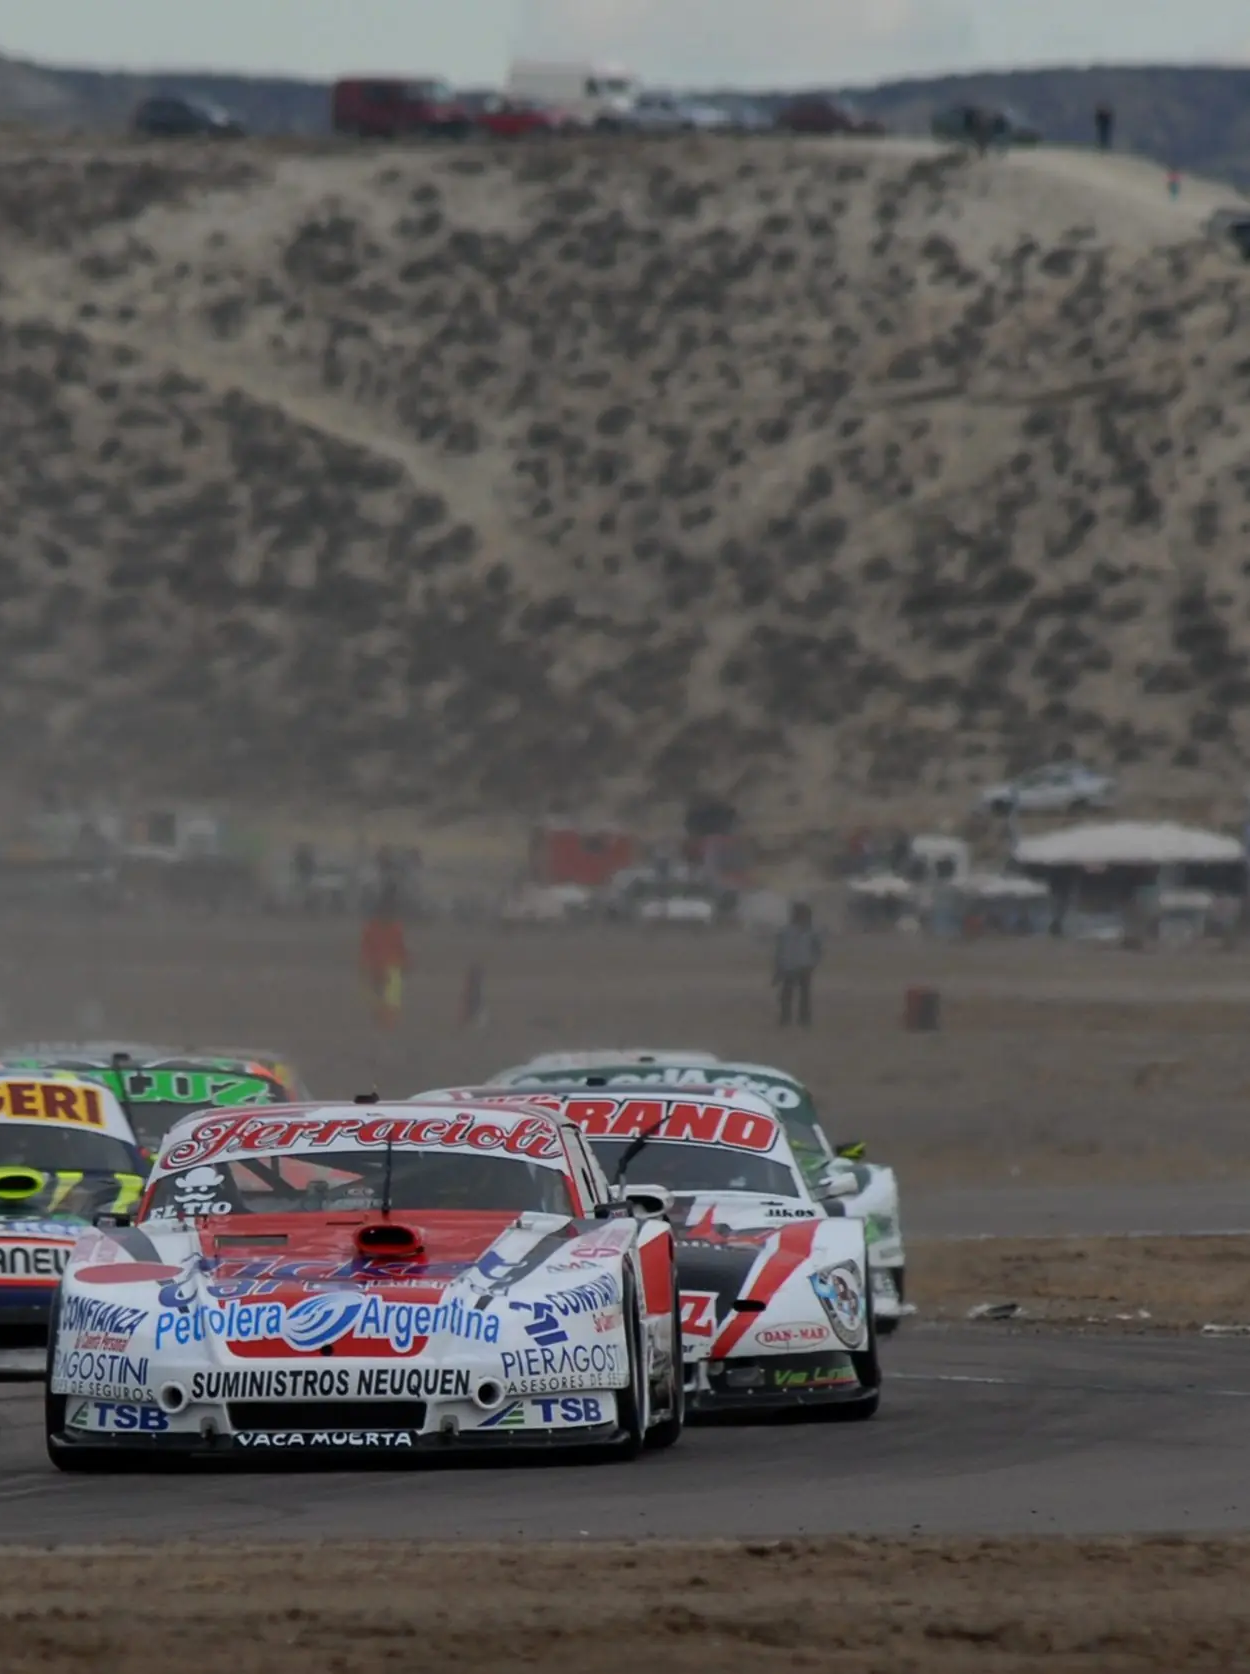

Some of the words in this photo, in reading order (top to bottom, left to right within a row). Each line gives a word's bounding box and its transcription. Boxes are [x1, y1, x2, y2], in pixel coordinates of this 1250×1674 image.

[183, 1201, 232, 1216] TIO
[155, 1302, 282, 1351] Petrolera
[360, 1296, 499, 1348] Argentina
[89, 1383, 154, 1401] SEGUROS
[191, 1369, 350, 1399] SUMINISTROS
[357, 1368, 471, 1398] NEUQUEN
[508, 1375, 585, 1395] ASESORES
[94, 1402, 170, 1431] TSB
[531, 1397, 602, 1423] TSB
[236, 1432, 305, 1448] VACA
[309, 1431, 413, 1448] MUERTA
